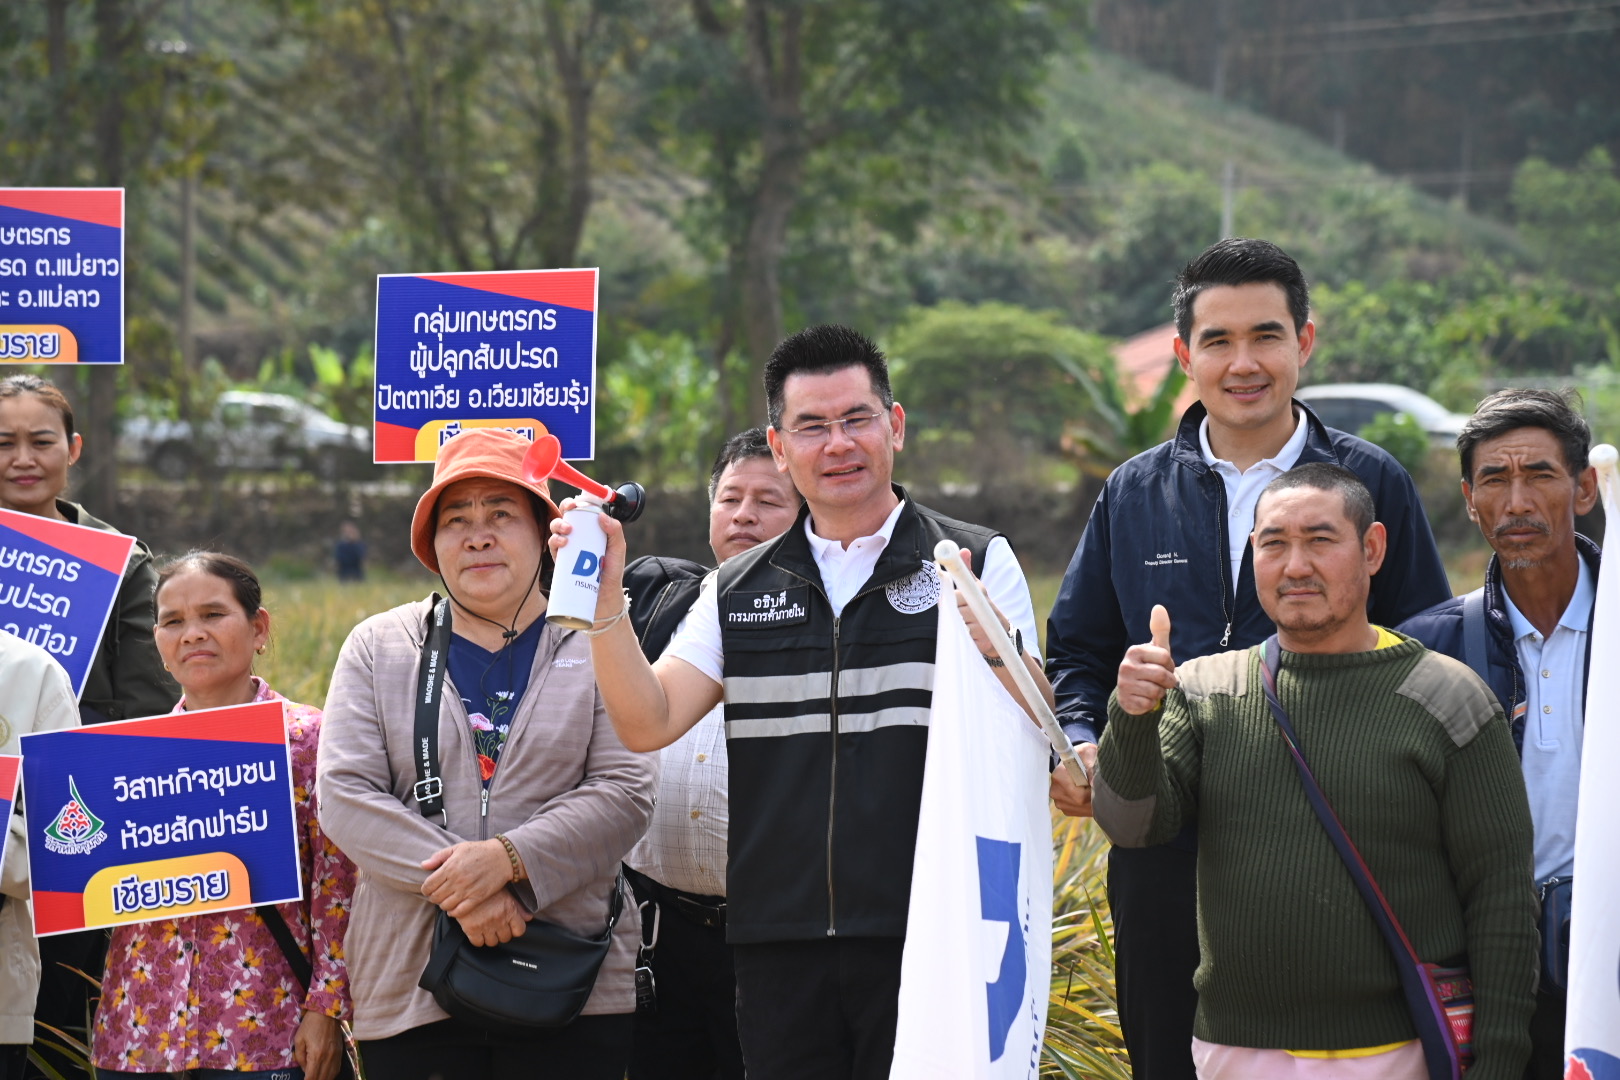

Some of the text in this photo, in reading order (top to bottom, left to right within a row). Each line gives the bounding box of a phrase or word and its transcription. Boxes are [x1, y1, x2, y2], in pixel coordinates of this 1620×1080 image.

[35, 252, 119, 276] ต.แม่ยาว
[17, 283, 100, 307] อ.แม่ลาว
[414, 304, 557, 341] กลุ่มเกษตรกร
[410, 341, 558, 378] ผู้ปลูกสับปะรด
[468, 379, 589, 413] อ.เวียงเชียงรุ้ง
[728, 603, 805, 622] กรมการค้าภายใน
[753, 590, 787, 608] อธิบดี
[113, 760, 276, 802] วิสาหกิจชุมชน
[121, 805, 269, 850] ห้วยสักฟาร์ม
[110, 868, 230, 914] เชียงราย
